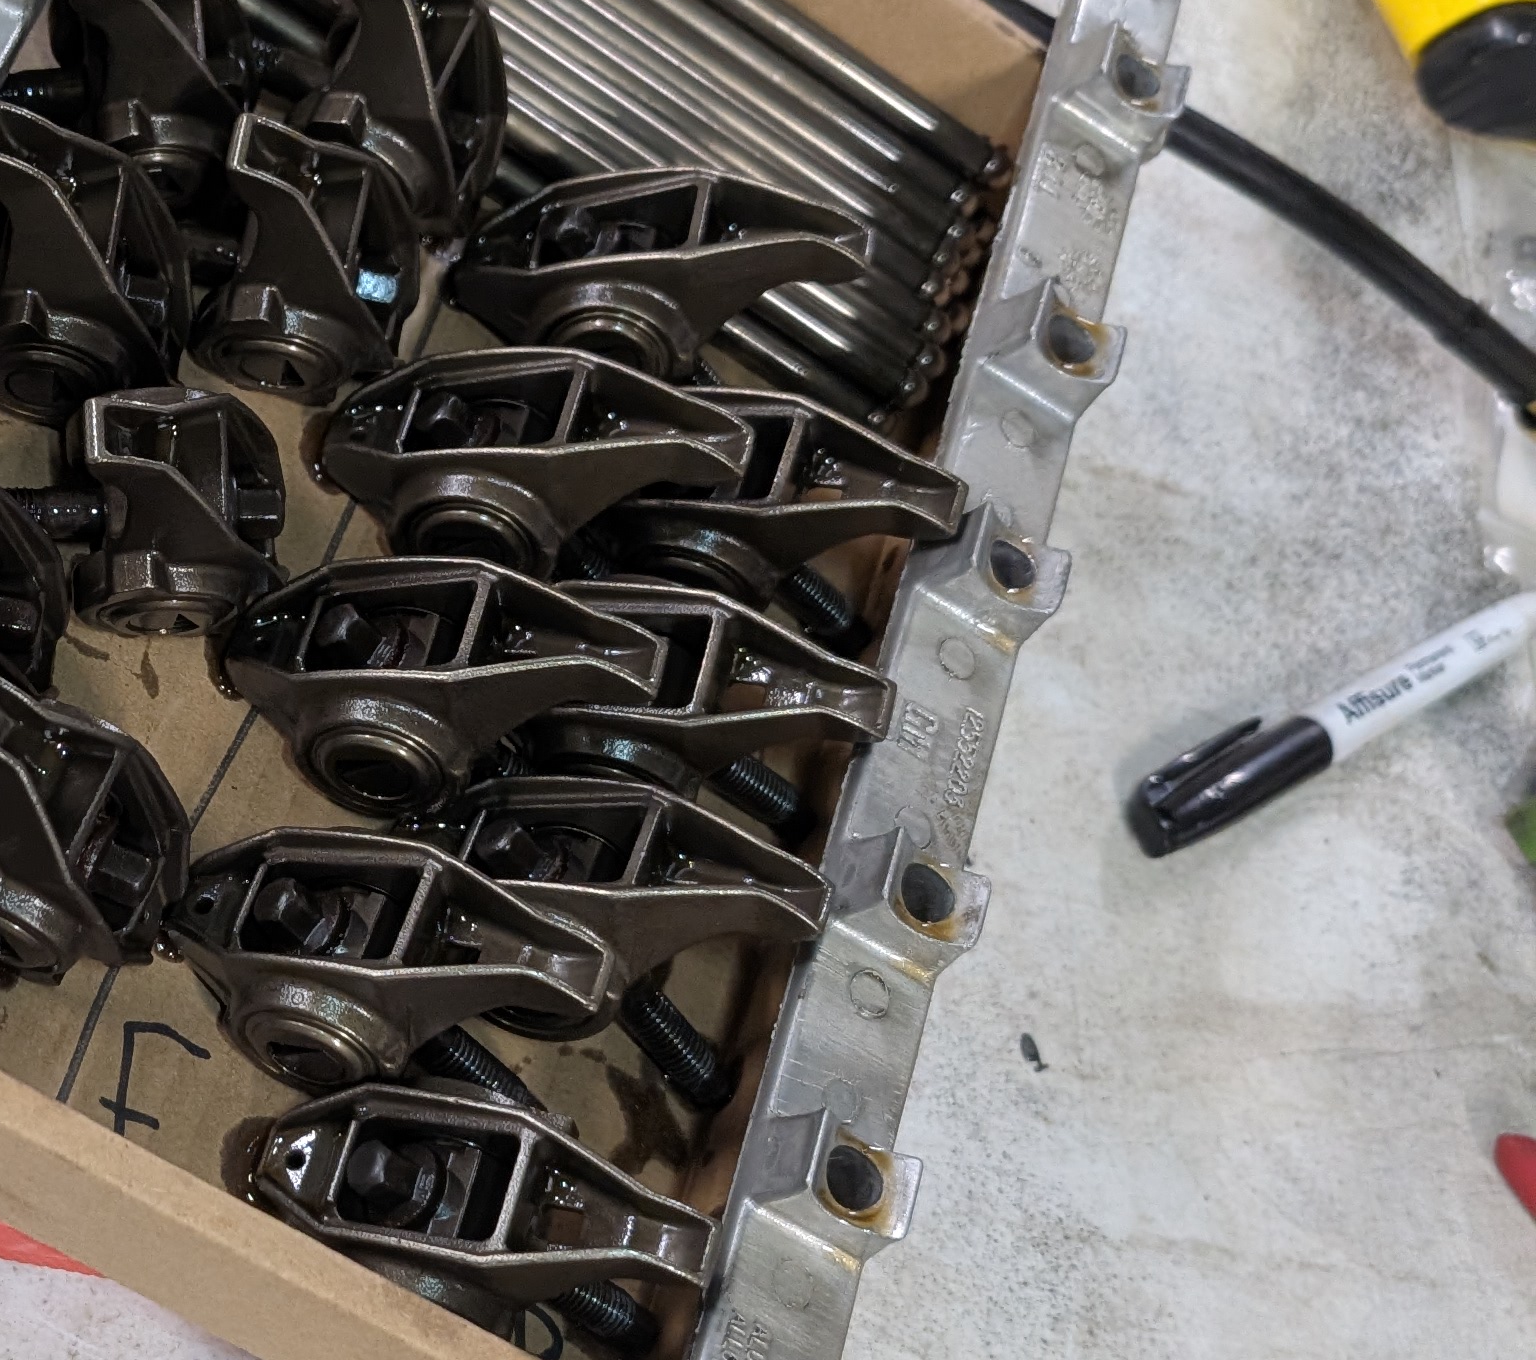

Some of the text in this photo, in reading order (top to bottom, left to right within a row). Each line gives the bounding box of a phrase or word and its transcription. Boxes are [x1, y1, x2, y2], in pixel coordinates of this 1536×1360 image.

[894, 701, 943, 761] GM
[940, 706, 988, 808] 12552203
[99, 1021, 211, 1137] F
